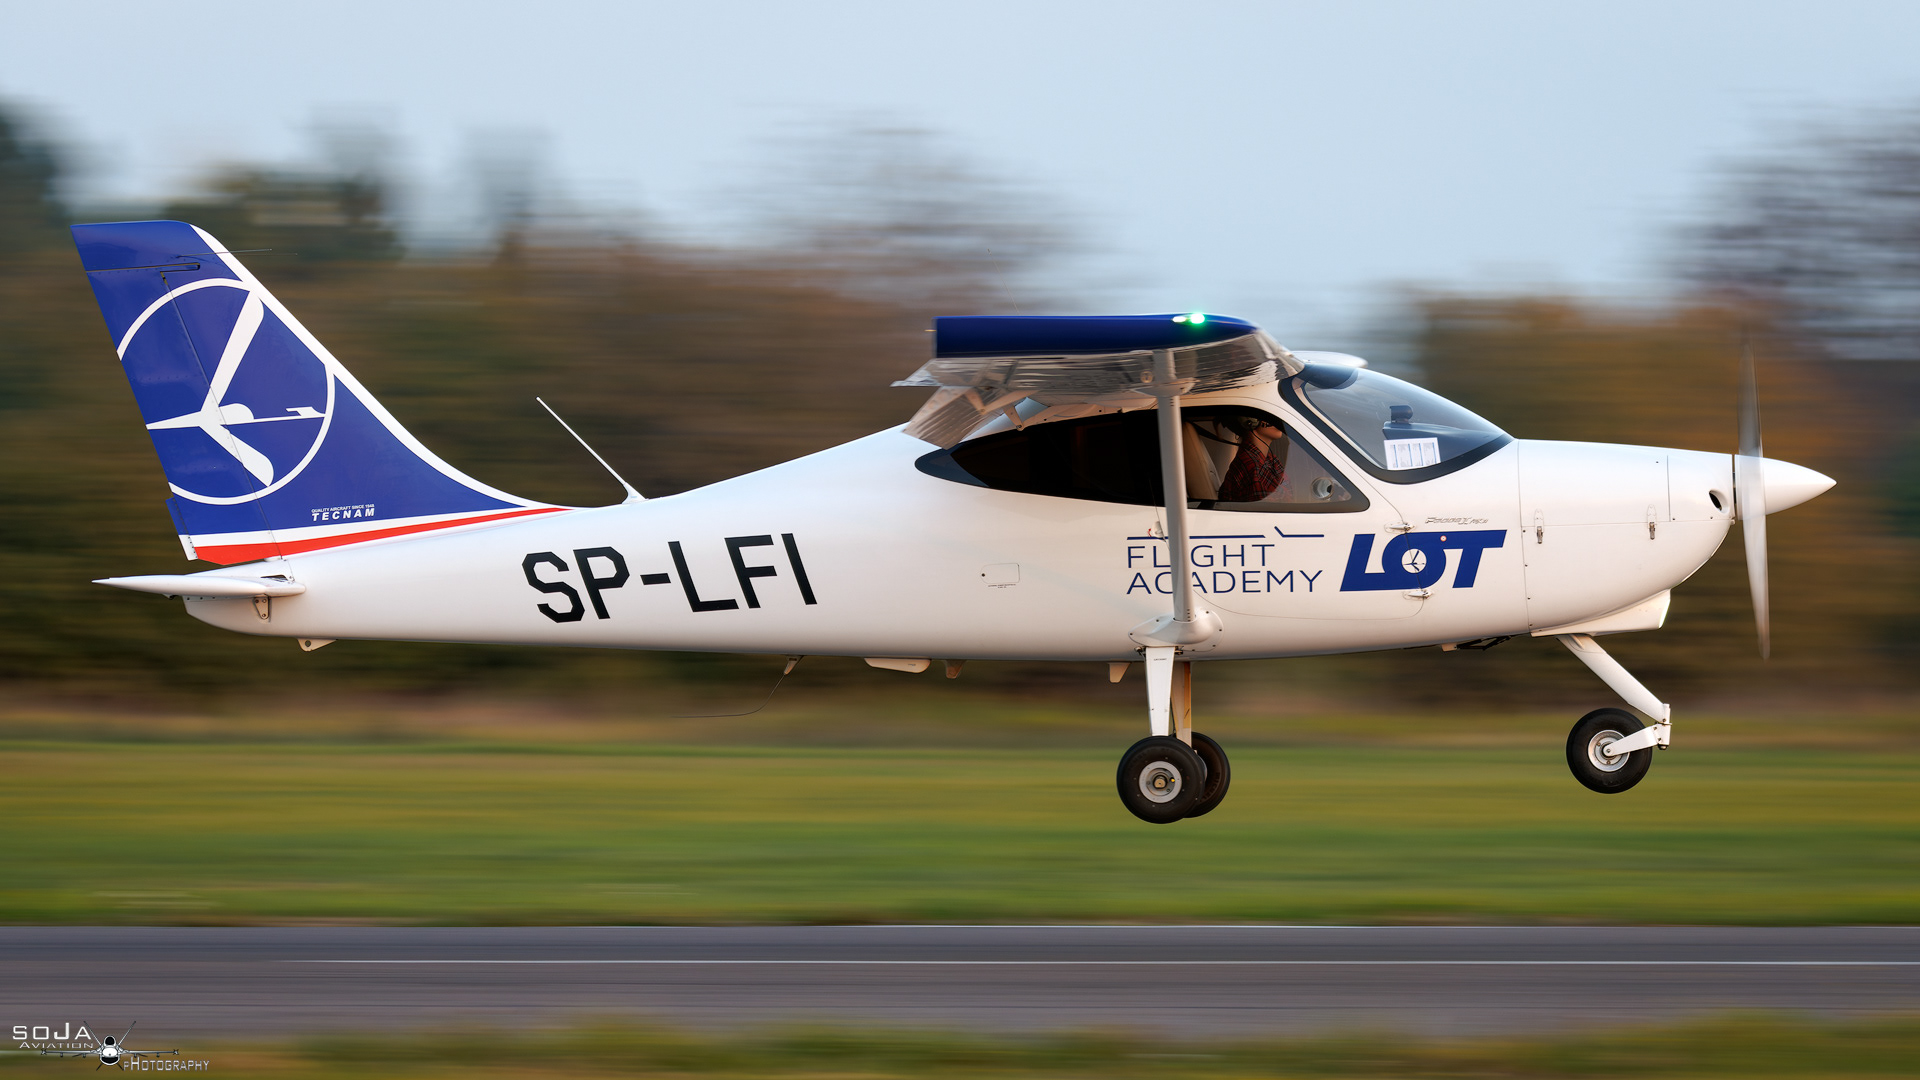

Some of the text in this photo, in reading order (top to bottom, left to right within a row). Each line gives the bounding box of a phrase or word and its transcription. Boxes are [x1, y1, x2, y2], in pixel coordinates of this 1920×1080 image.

[312, 508, 375, 521] TECNAM
[1127, 544, 1275, 568] FLGHT
[1340, 530, 1507, 592] LOT
[522, 533, 817, 623] SP-LFI
